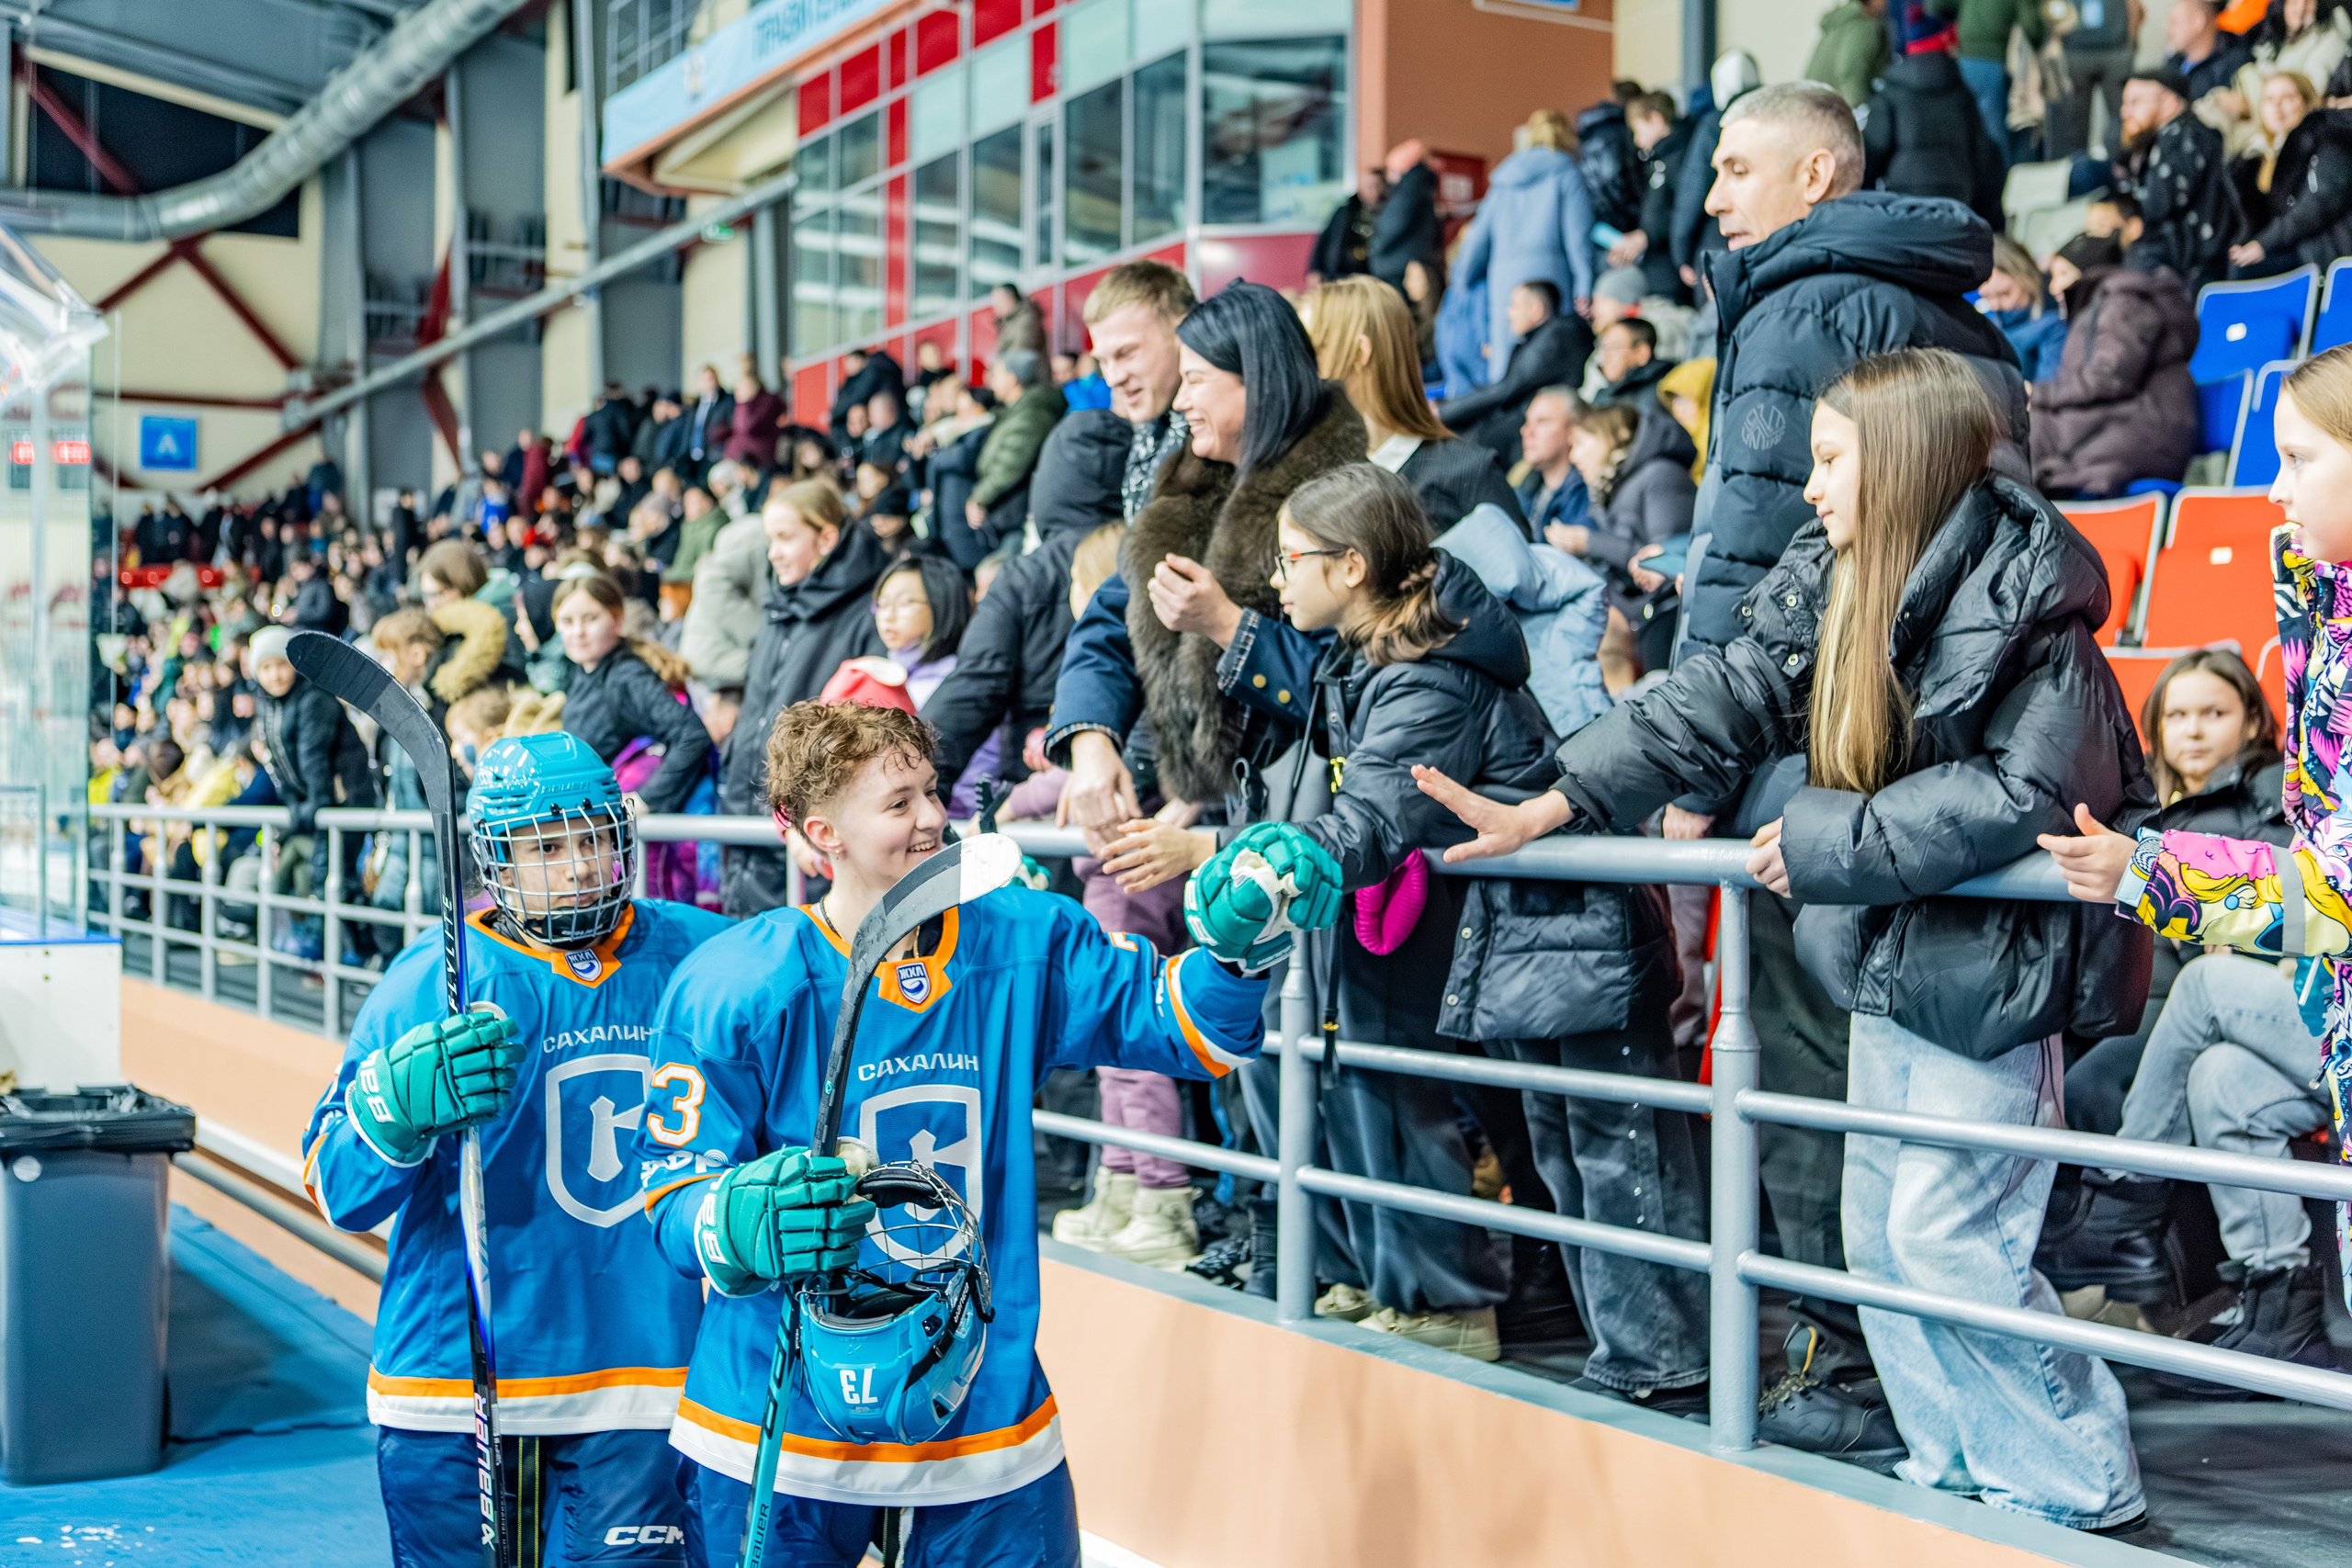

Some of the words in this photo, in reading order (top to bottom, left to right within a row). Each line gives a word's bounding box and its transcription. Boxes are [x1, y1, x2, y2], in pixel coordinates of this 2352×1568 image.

[442, 894, 458, 1014] FLYLITE
[568, 952, 594, 964] ЖХЛ
[899, 965, 924, 980] ЖХЛ
[543, 1025, 651, 1054] САХАЛИН
[857, 1053, 979, 1082] САХАЛИН
[647, 1062, 706, 1147] 3
[839, 1368, 879, 1404] 73
[474, 1393, 495, 1522] BAUER
[604, 1525, 685, 1545] CCM
